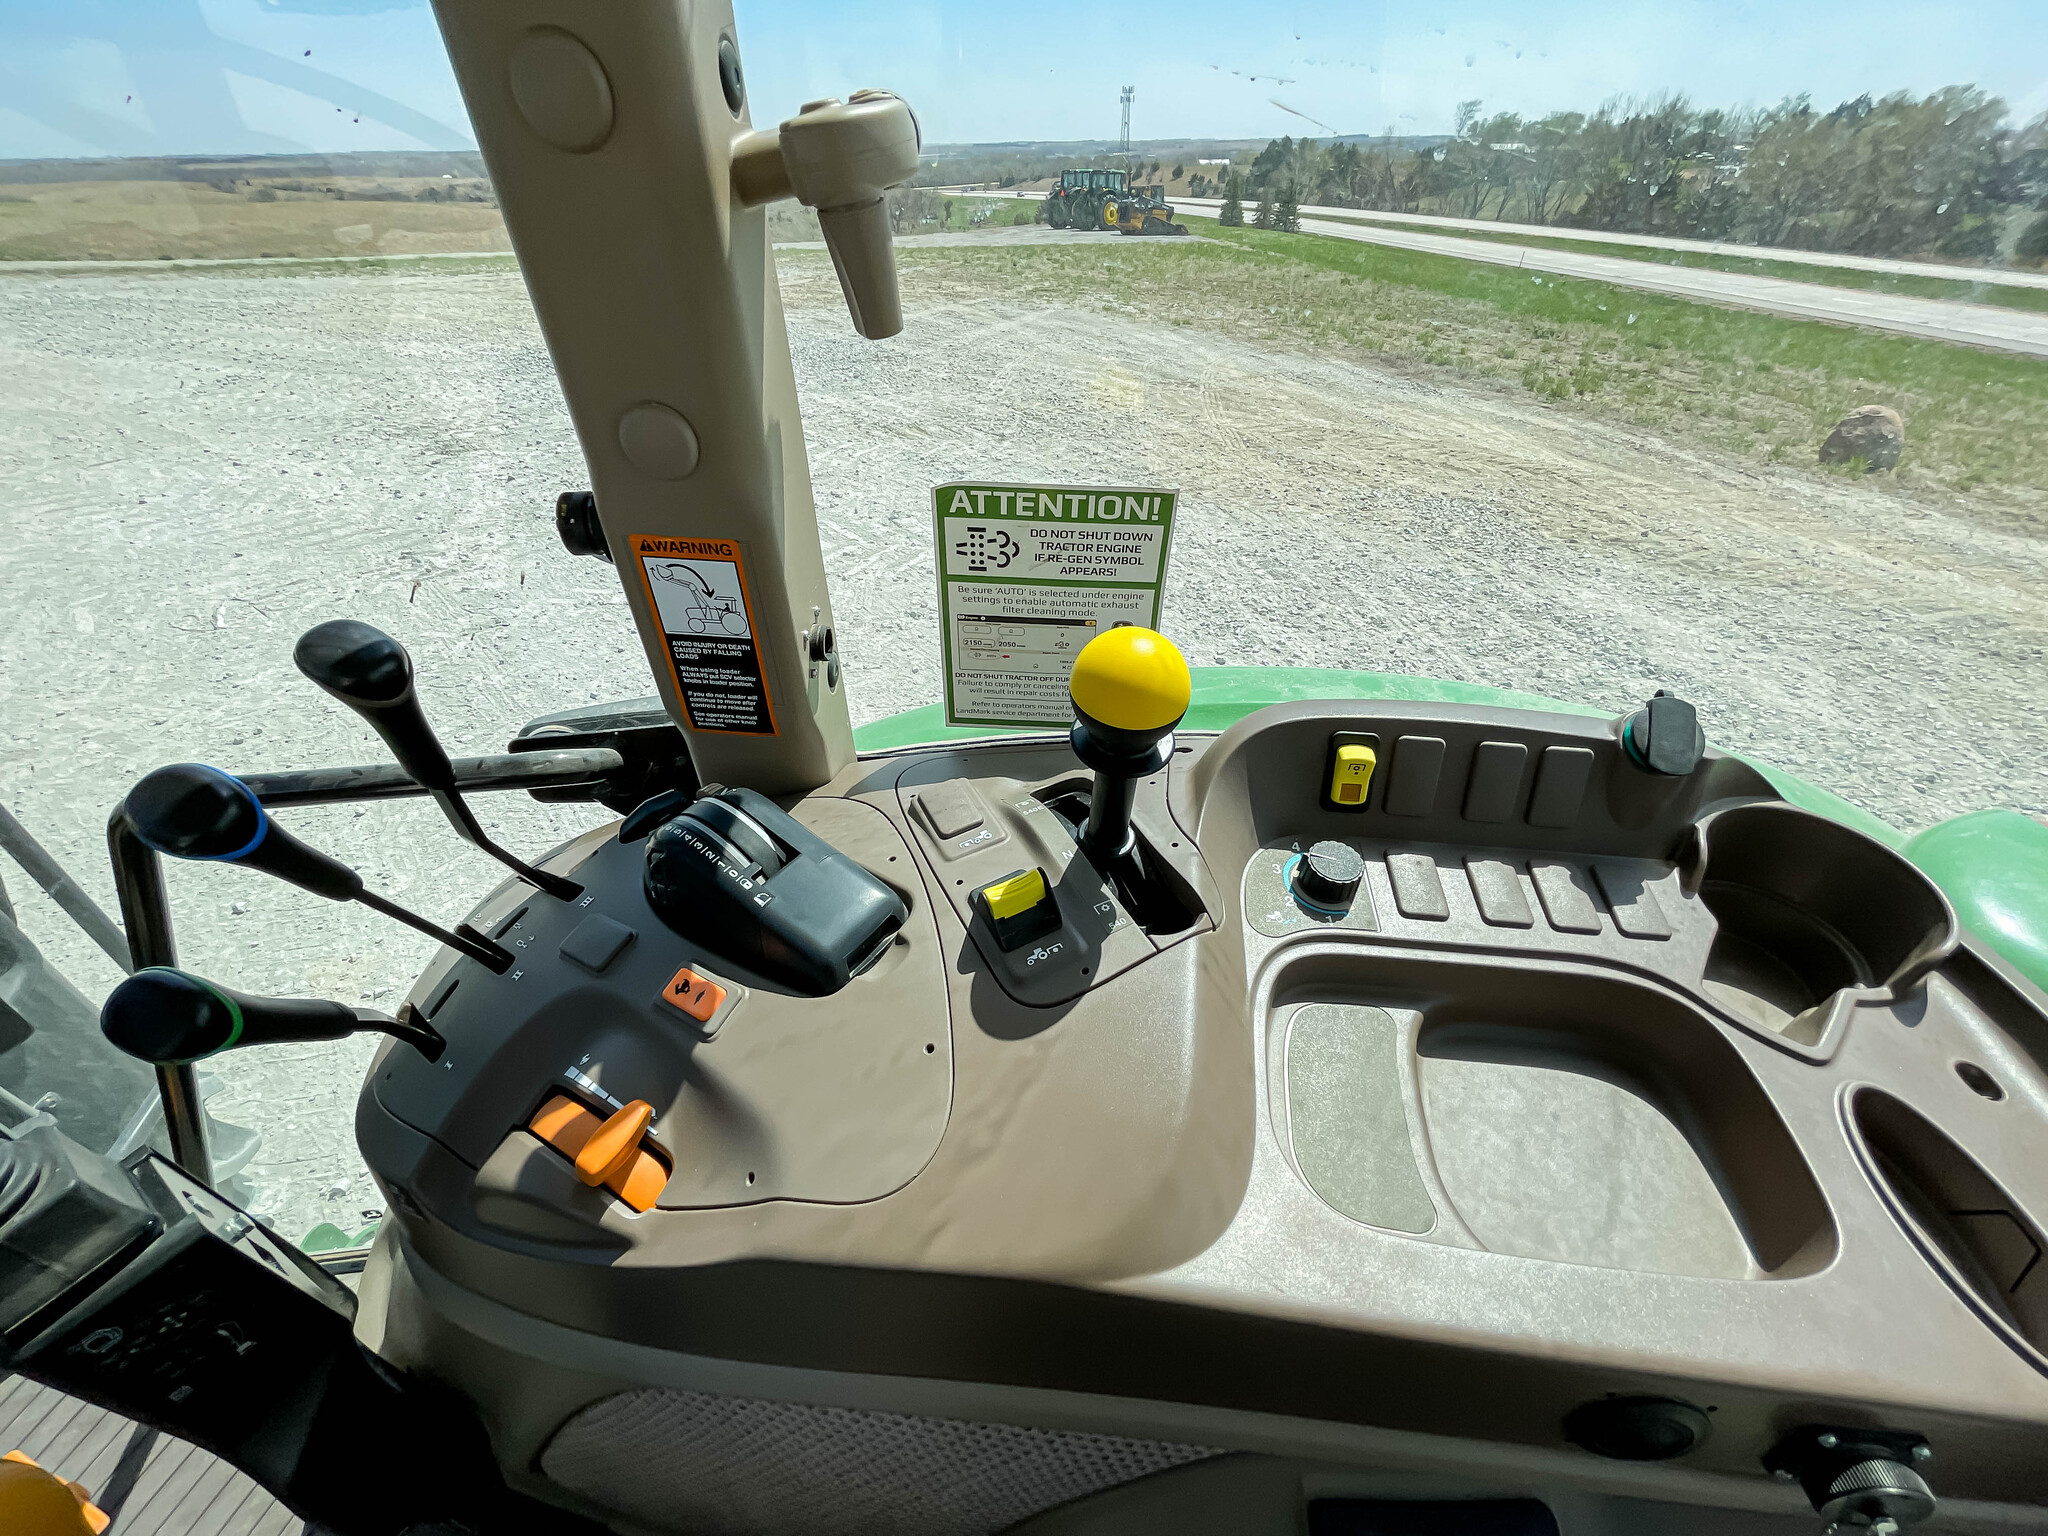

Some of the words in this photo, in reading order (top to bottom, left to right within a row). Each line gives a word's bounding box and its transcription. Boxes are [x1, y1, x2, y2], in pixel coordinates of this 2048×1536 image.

[949, 490, 1161, 520] ATTENTION!
[1030, 529, 1048, 538] DO
[1050, 530, 1075, 539] NOT
[1078, 531, 1112, 540] SHUT
[1114, 532, 1153, 541] DOWN
[653, 541, 732, 556] WARNING
[1039, 542, 1093, 552] TRACTOR
[1097, 544, 1142, 553] ENGINE
[1035, 553, 1045, 562] IF
[1048, 554, 1092, 564] RE-GEN
[1095, 556, 1144, 565] SYMBOL
[1060, 567, 1116, 576] APPEARS!
[1082, 591, 1110, 599] under
[1112, 593, 1144, 601] engine
[962, 596, 1000, 605] settings
[1016, 598, 1047, 606] enable
[1050, 599, 1098, 608] automatic
[1101, 601, 1139, 610] exhaust
[1002, 605, 1025, 614] filter
[1027, 607, 1065, 617] cleaning
[1292, 842, 1300, 851] 4
[706, 851, 715, 859] 2
[1062, 850, 1074, 859] N
[1272, 864, 1280, 874] 3
[1285, 896, 1295, 907] 2
[1108, 918, 1126, 929] 540
